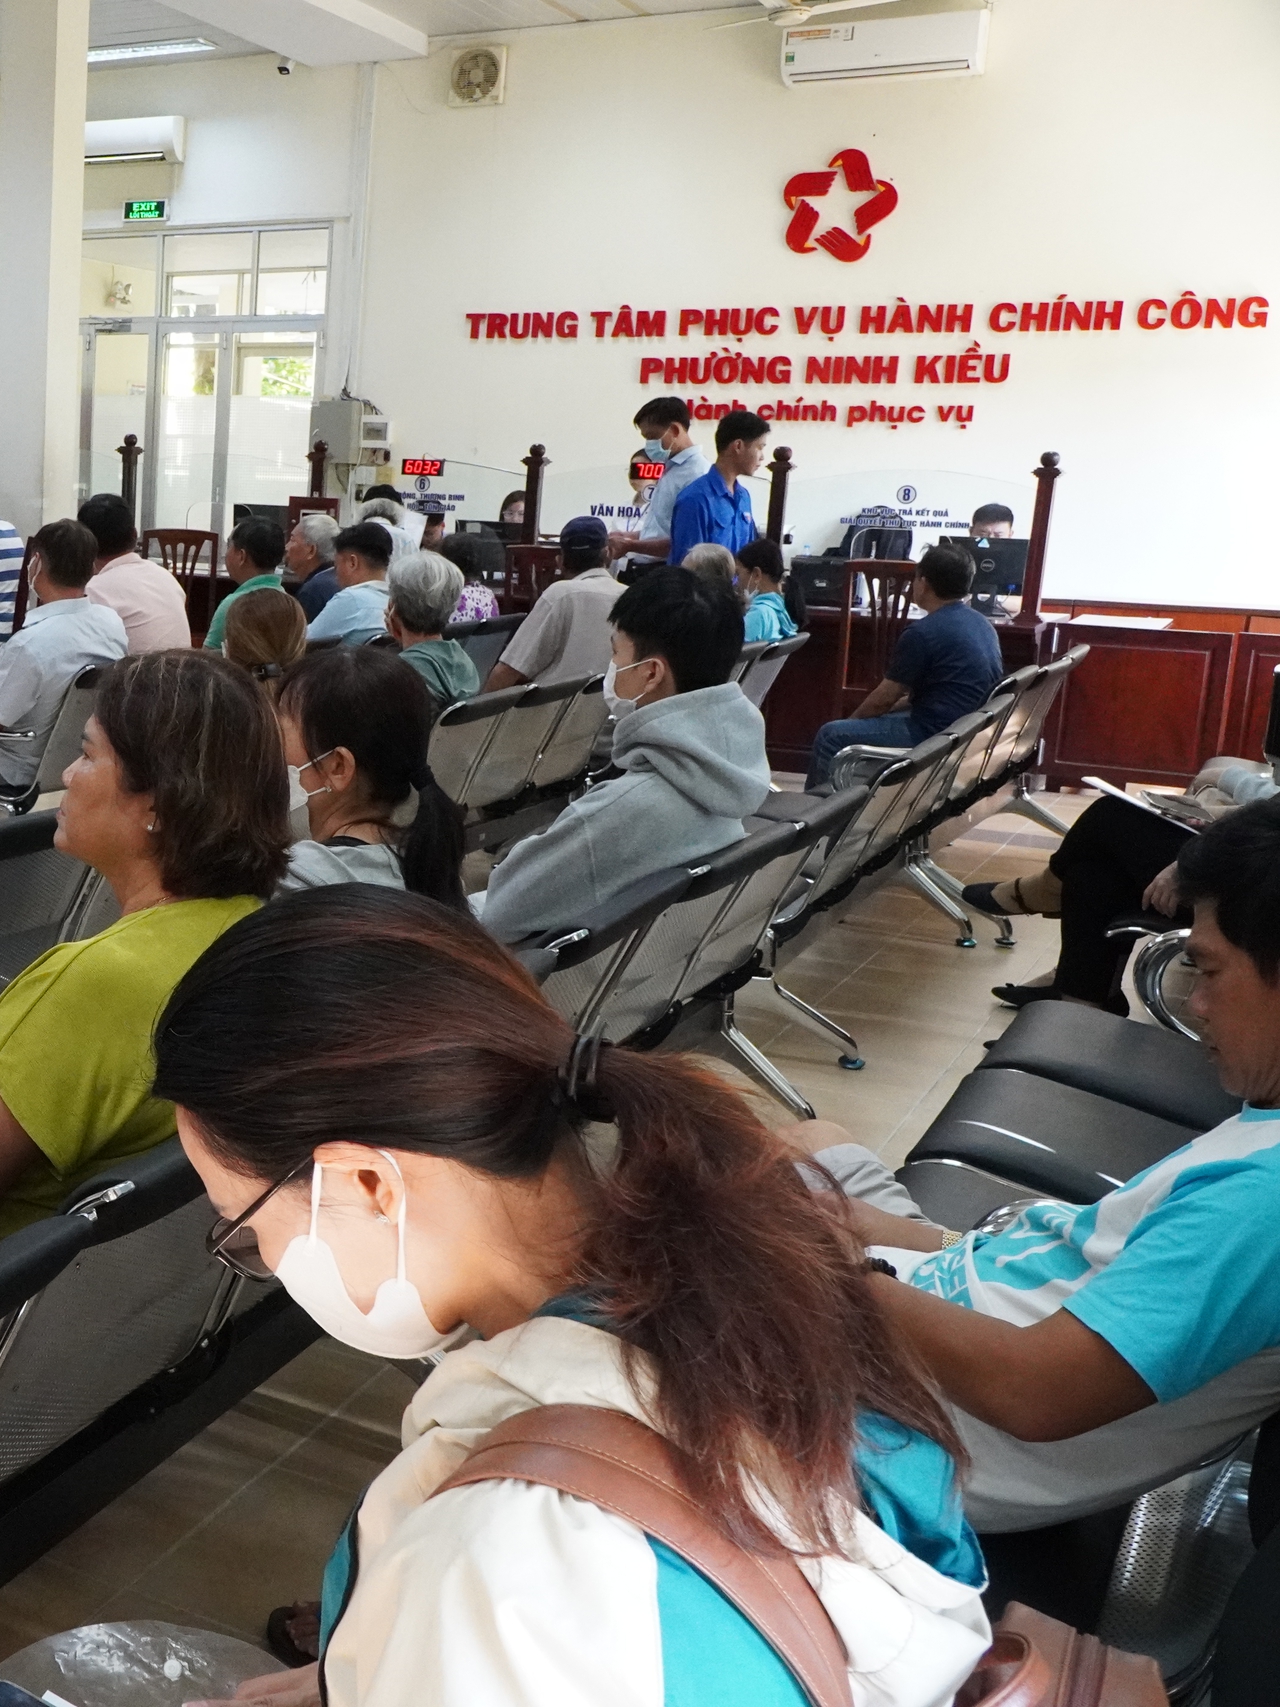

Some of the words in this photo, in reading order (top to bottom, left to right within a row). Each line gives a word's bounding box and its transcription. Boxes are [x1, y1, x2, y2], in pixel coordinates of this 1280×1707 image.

[132, 202, 157, 211] EXIT
[466, 311, 578, 339] TRUNG
[590, 305, 666, 337] TÂM
[679, 307, 779, 342] PHỤC
[795, 306, 846, 342] VỤ
[859, 297, 974, 334] HÀNH
[989, 294, 1124, 332] CHÍNH
[1137, 291, 1270, 330] CÔNG
[639, 348, 792, 384] PHƯỜNG
[805, 356, 899, 384] NINH
[914, 340, 1011, 384] KIỀU
[757, 397, 837, 422] chính
[847, 400, 926, 430] phục
[938, 406, 974, 429] vụ
[404, 460, 440, 474] 6032
[637, 464, 664, 478] 700
[420, 478, 426, 490] 6
[420, 493, 446, 501] THƯƠNG
[648, 487, 655, 499] 7
[903, 488, 911, 501] 8
[590, 504, 614, 517] VĂN
[862, 507, 878, 515] KHU
[898, 508, 913, 516] TRẢ
[916, 508, 930, 516] KẾT
[932, 509, 948, 518] QUẢ
[920, 520, 942, 528] HÀNH
[945, 521, 971, 529] CHÍNH
